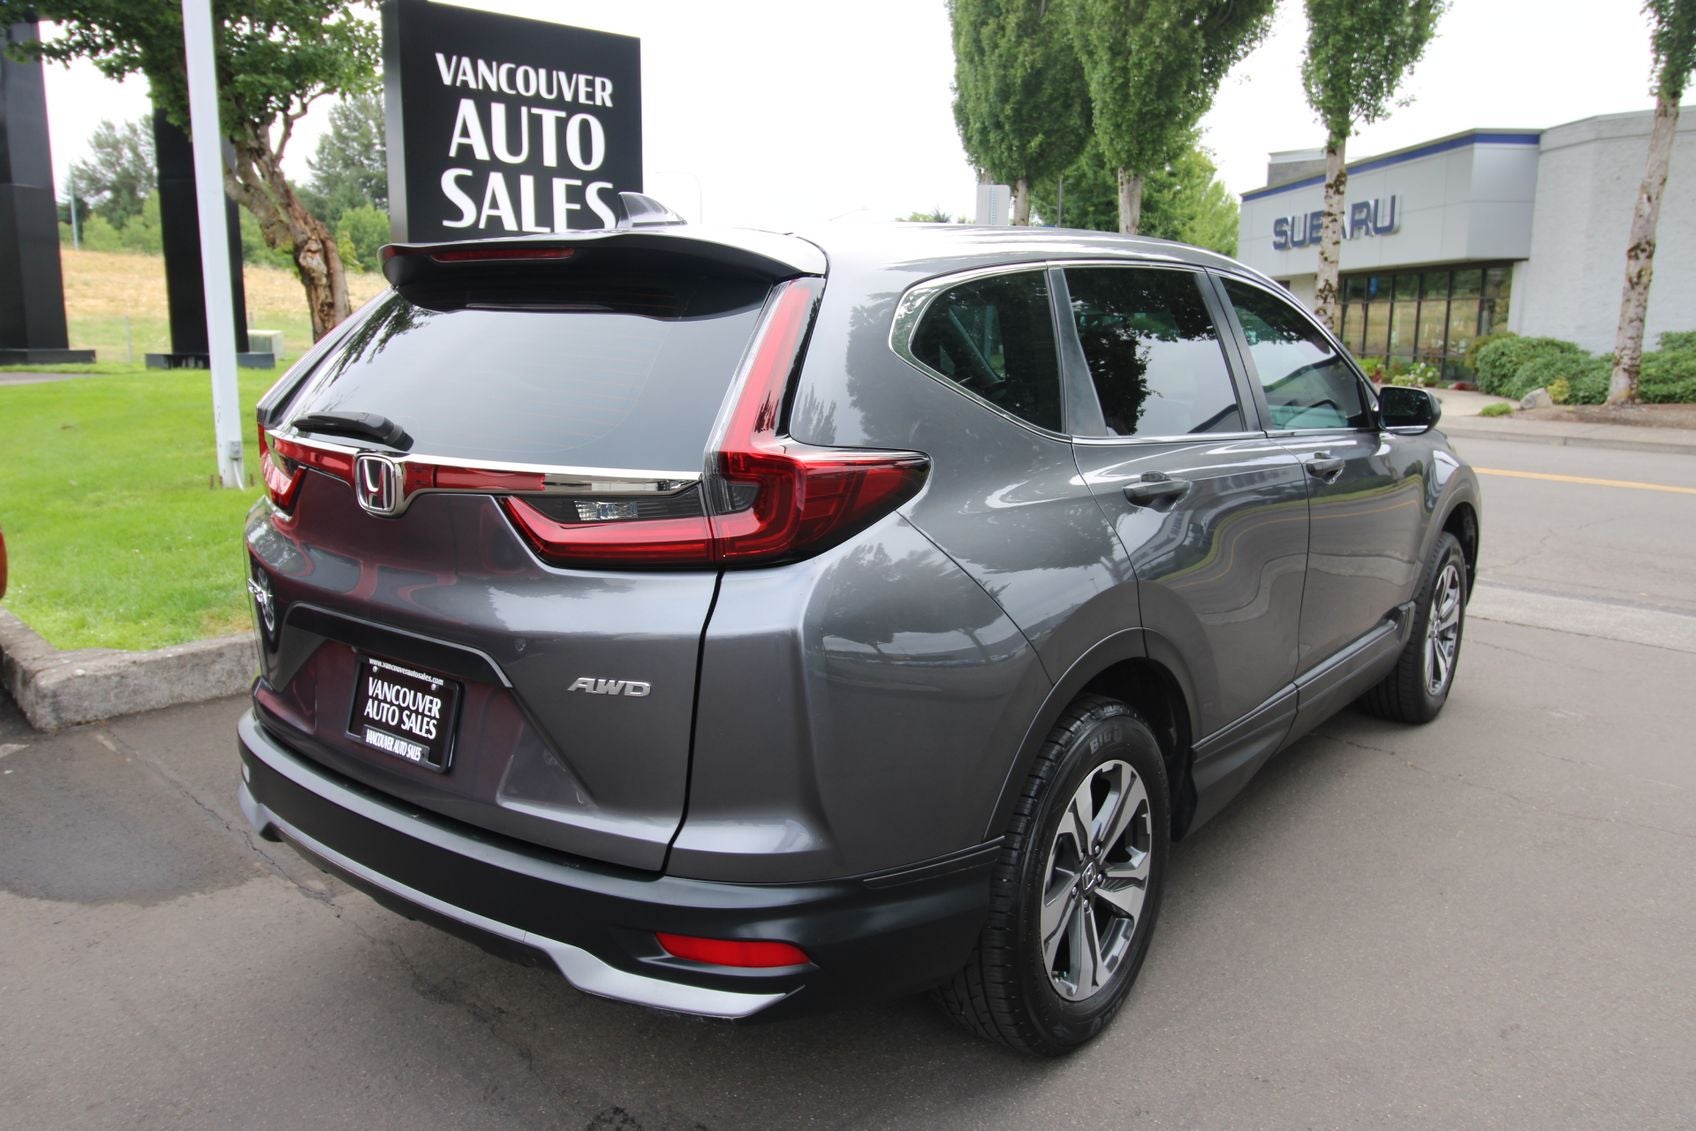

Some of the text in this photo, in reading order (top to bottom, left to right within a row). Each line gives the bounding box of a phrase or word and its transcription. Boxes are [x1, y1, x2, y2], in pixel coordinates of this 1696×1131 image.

[435, 52, 613, 107] VANCOUVER
[449, 98, 605, 171] AUTO
[440, 168, 617, 233] SALES
[368, 677, 441, 718] VANCOUVER
[568, 677, 651, 696] AWD
[364, 699, 437, 739] AUTO SALES
[393, 739, 408, 756] AUTO
[406, 744, 422, 762] SALES
